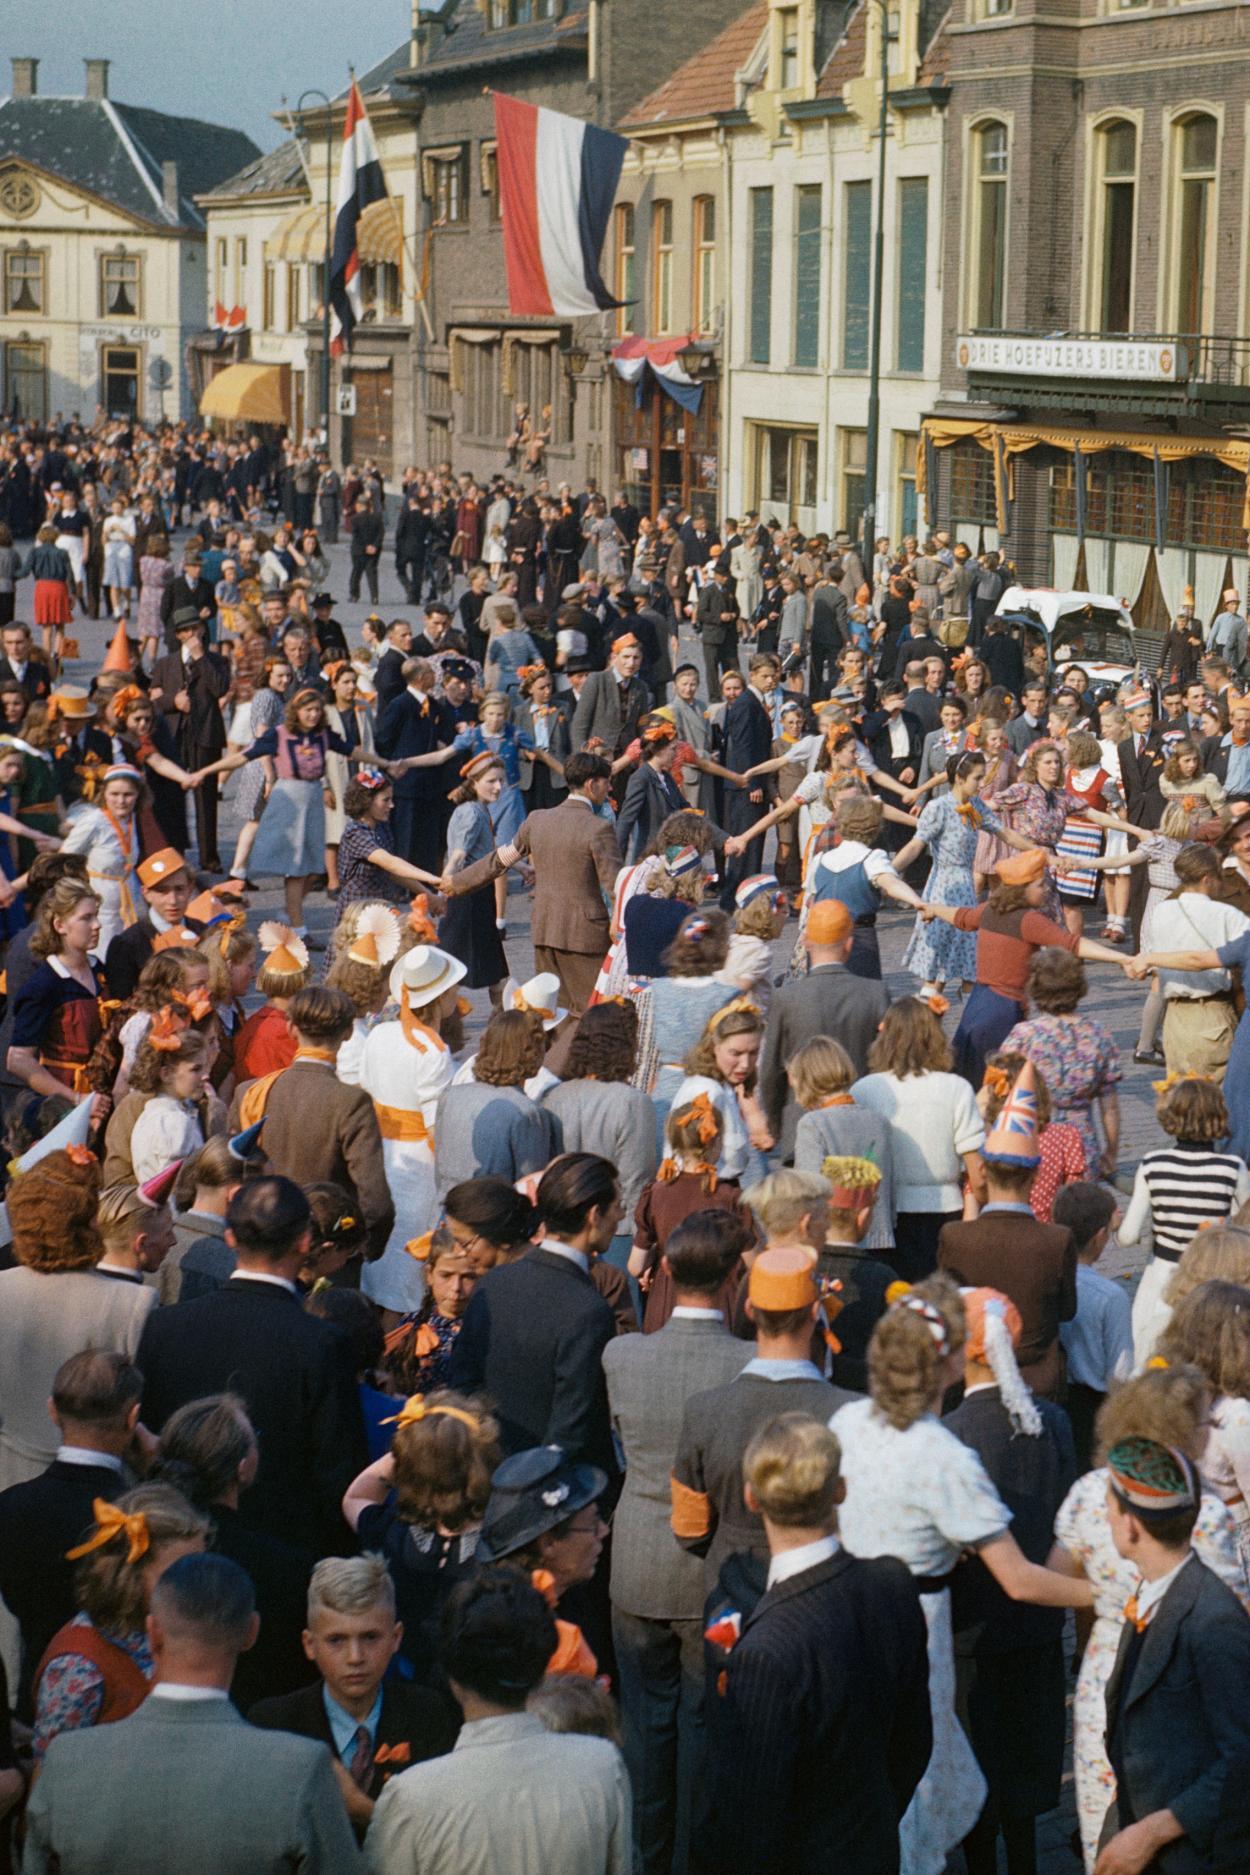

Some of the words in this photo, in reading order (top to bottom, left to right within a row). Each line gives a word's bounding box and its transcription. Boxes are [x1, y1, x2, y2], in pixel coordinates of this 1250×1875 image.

[130, 327, 161, 339] CITO
[971, 342, 1000, 364] DRIE
[1100, 348, 1158, 371] BIEREN
